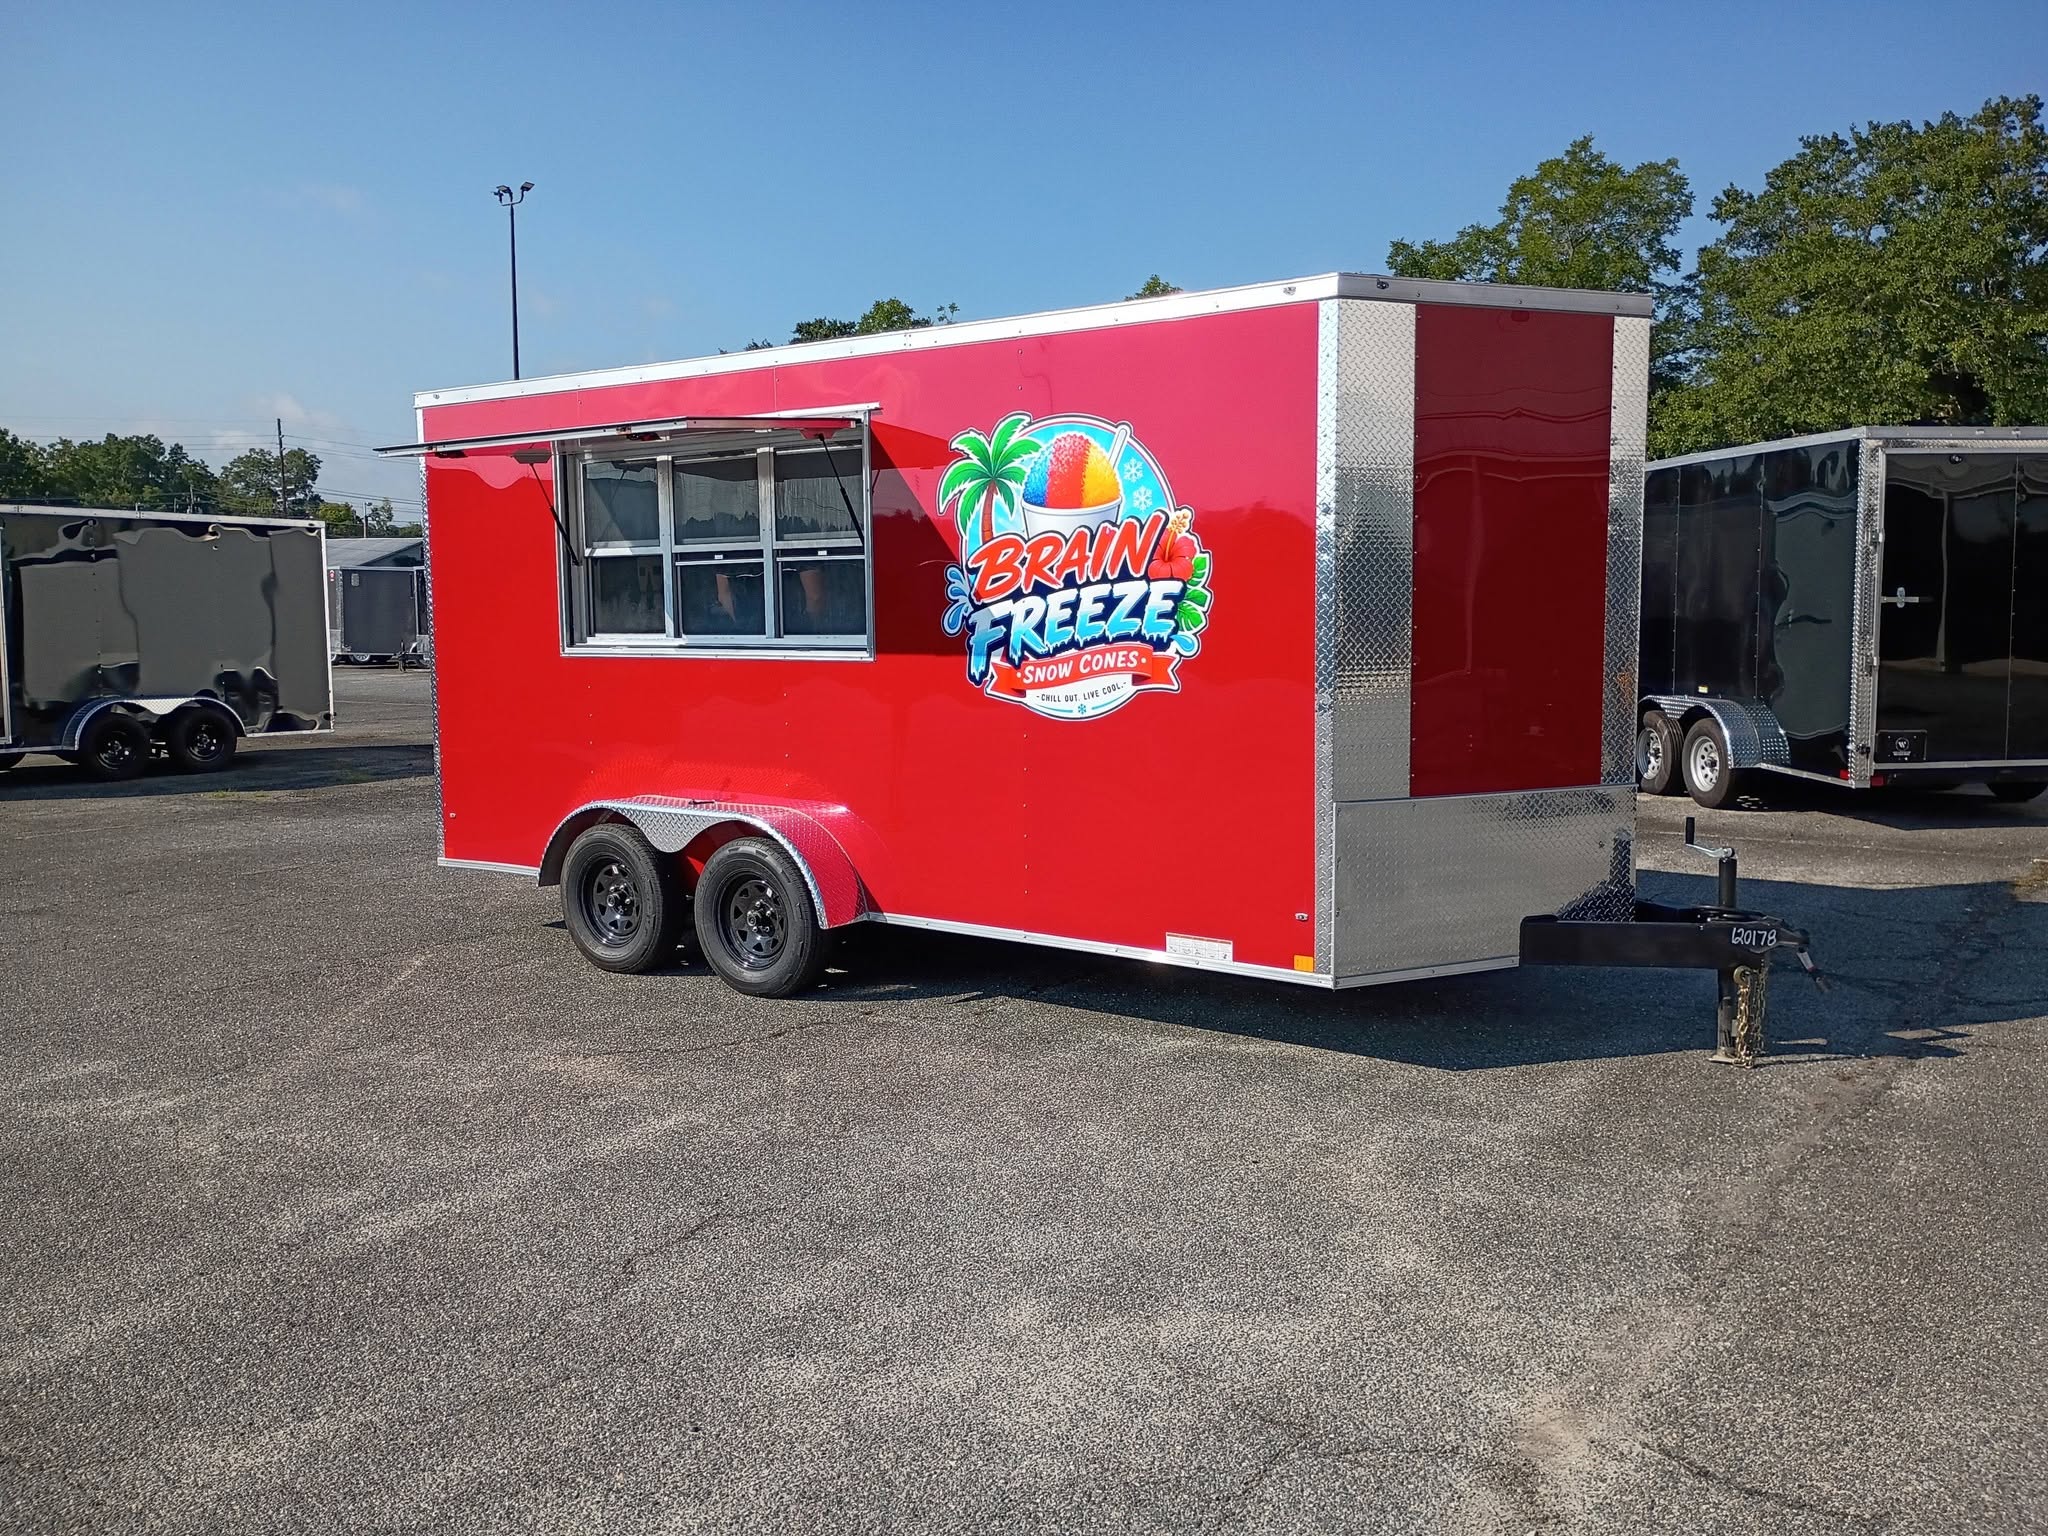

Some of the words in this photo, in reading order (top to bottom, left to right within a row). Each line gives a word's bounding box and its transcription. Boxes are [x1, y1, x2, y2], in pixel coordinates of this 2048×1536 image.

[969, 513, 1164, 603] BRAIN
[969, 580, 1184, 681] FREEZE
[1023, 660, 1073, 684] SNOW
[1079, 651, 1139, 674] CONES
[1083, 689, 1099, 701] LIVE
